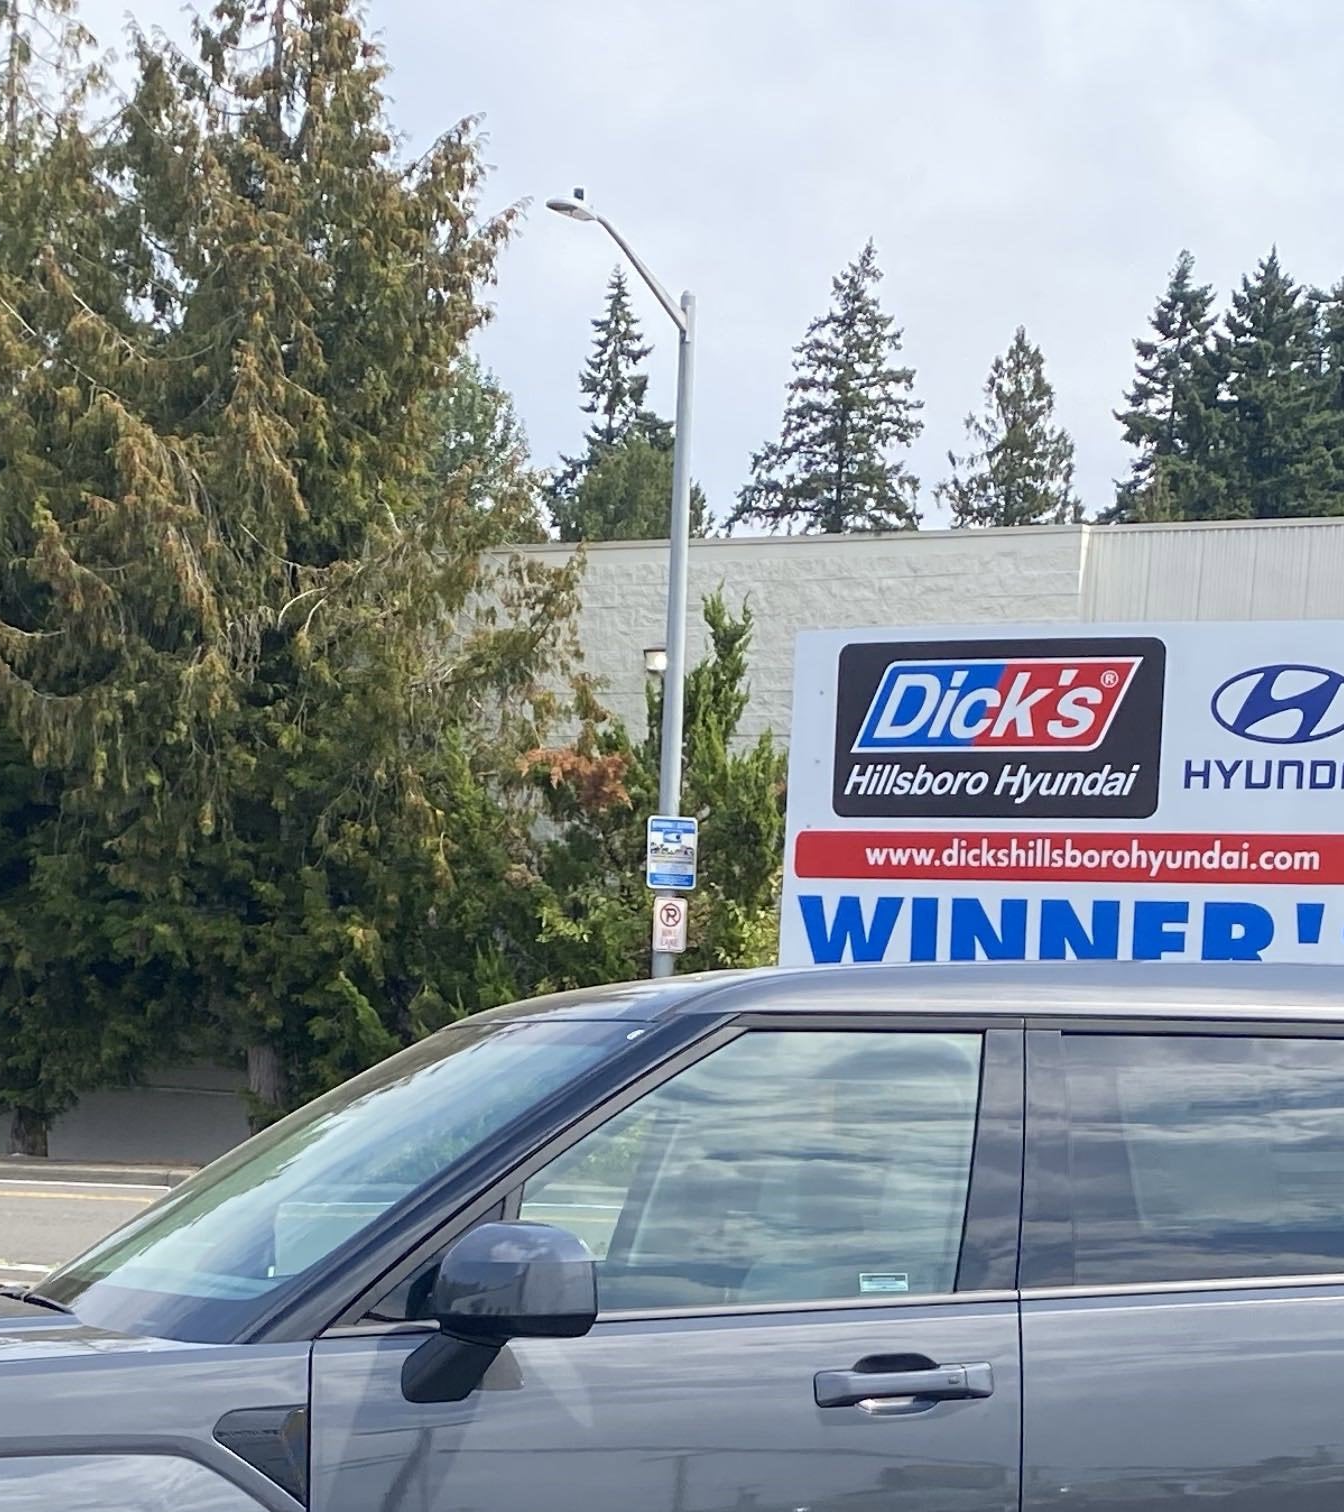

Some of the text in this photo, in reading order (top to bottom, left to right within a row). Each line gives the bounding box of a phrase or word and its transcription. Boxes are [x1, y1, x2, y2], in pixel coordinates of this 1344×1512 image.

[843, 763, 1139, 804] Hillsboro Hyundai
[865, 839, 1320, 878] www.dickshillsborohyundai.com
